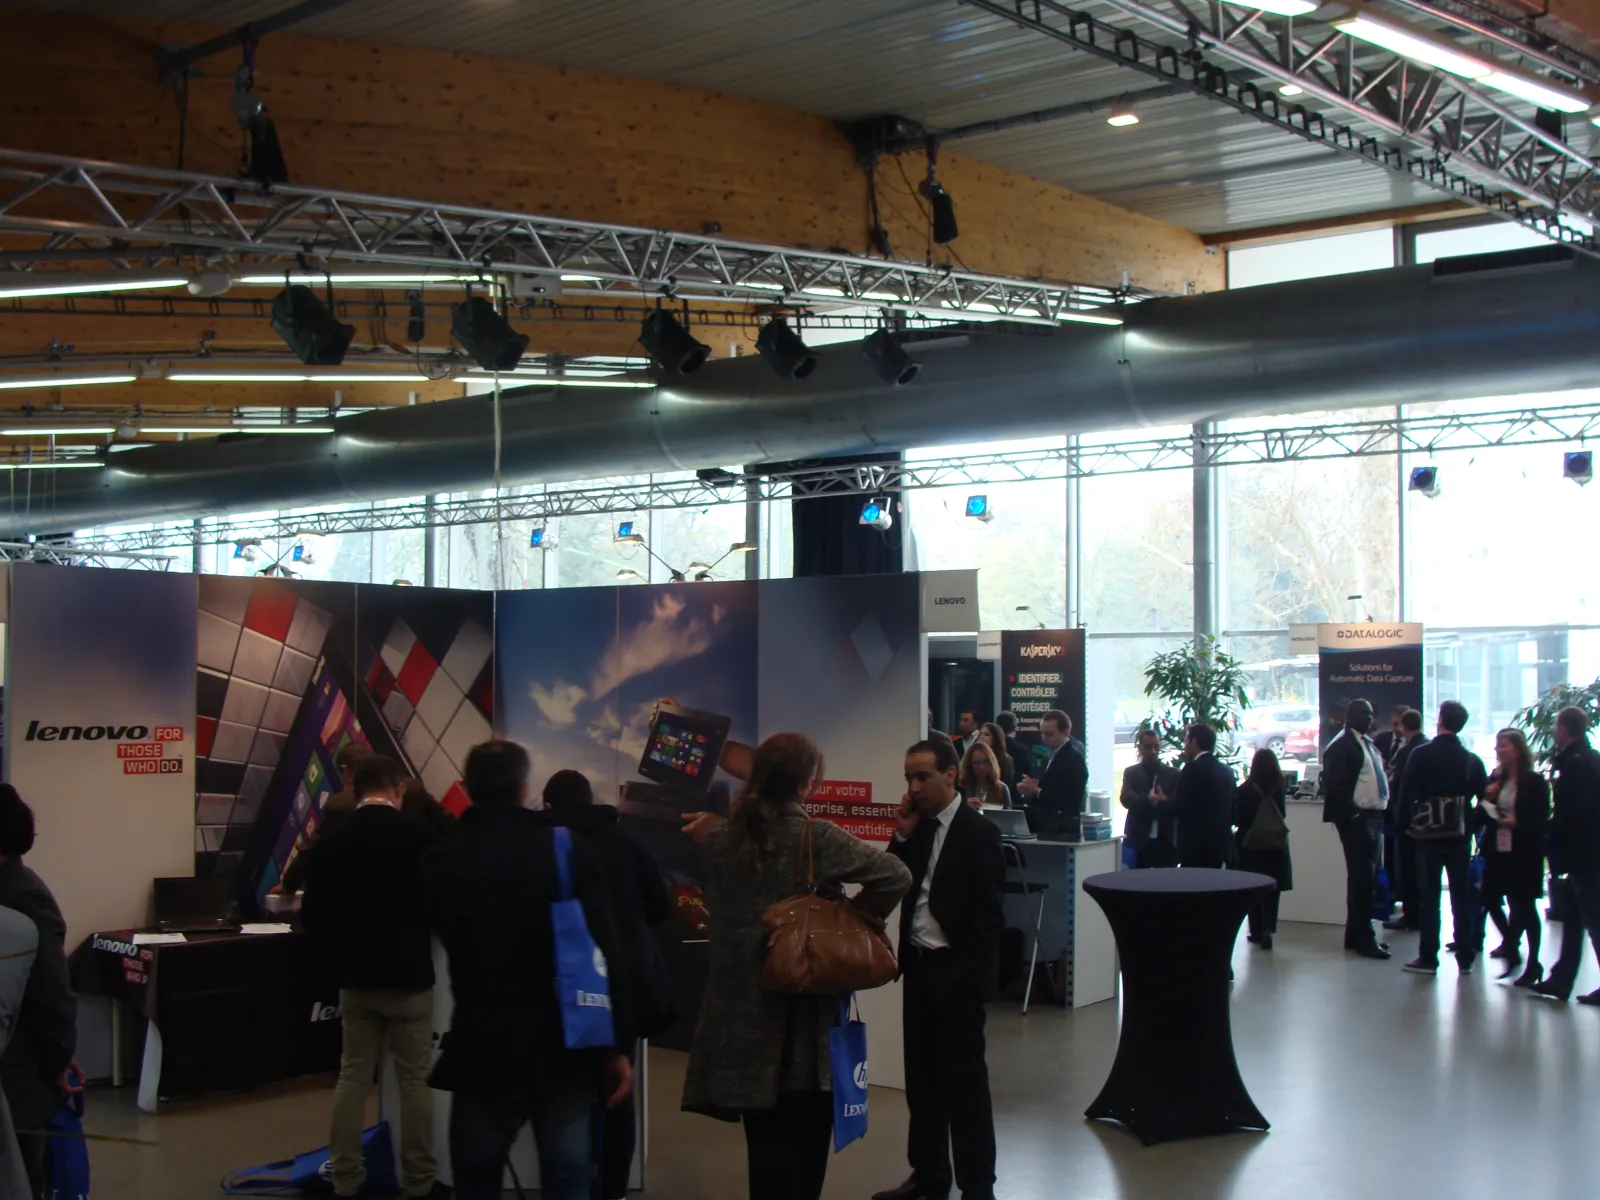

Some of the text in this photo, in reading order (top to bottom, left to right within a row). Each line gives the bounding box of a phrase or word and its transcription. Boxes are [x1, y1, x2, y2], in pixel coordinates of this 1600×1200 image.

[934, 597, 966, 605] LENOVO
[1345, 629, 1403, 639] DATALOGIC
[1020, 644, 1062, 658] KASPERSKY
[1349, 663, 1394, 672] Solutions for
[1018, 673, 1062, 683] IDENTIFIER.
[1329, 673, 1414, 683] Automatic Data Capture
[1011, 685, 1057, 697] CONTRÔLER.
[25, 720, 181, 741] lenovo FOR
[119, 744, 161, 757] THOSE
[126, 760, 182, 773] WHO DO.
[835, 784, 866, 796] votre
[843, 823, 897, 837] quotidie
[92, 933, 138, 957] lenovo
